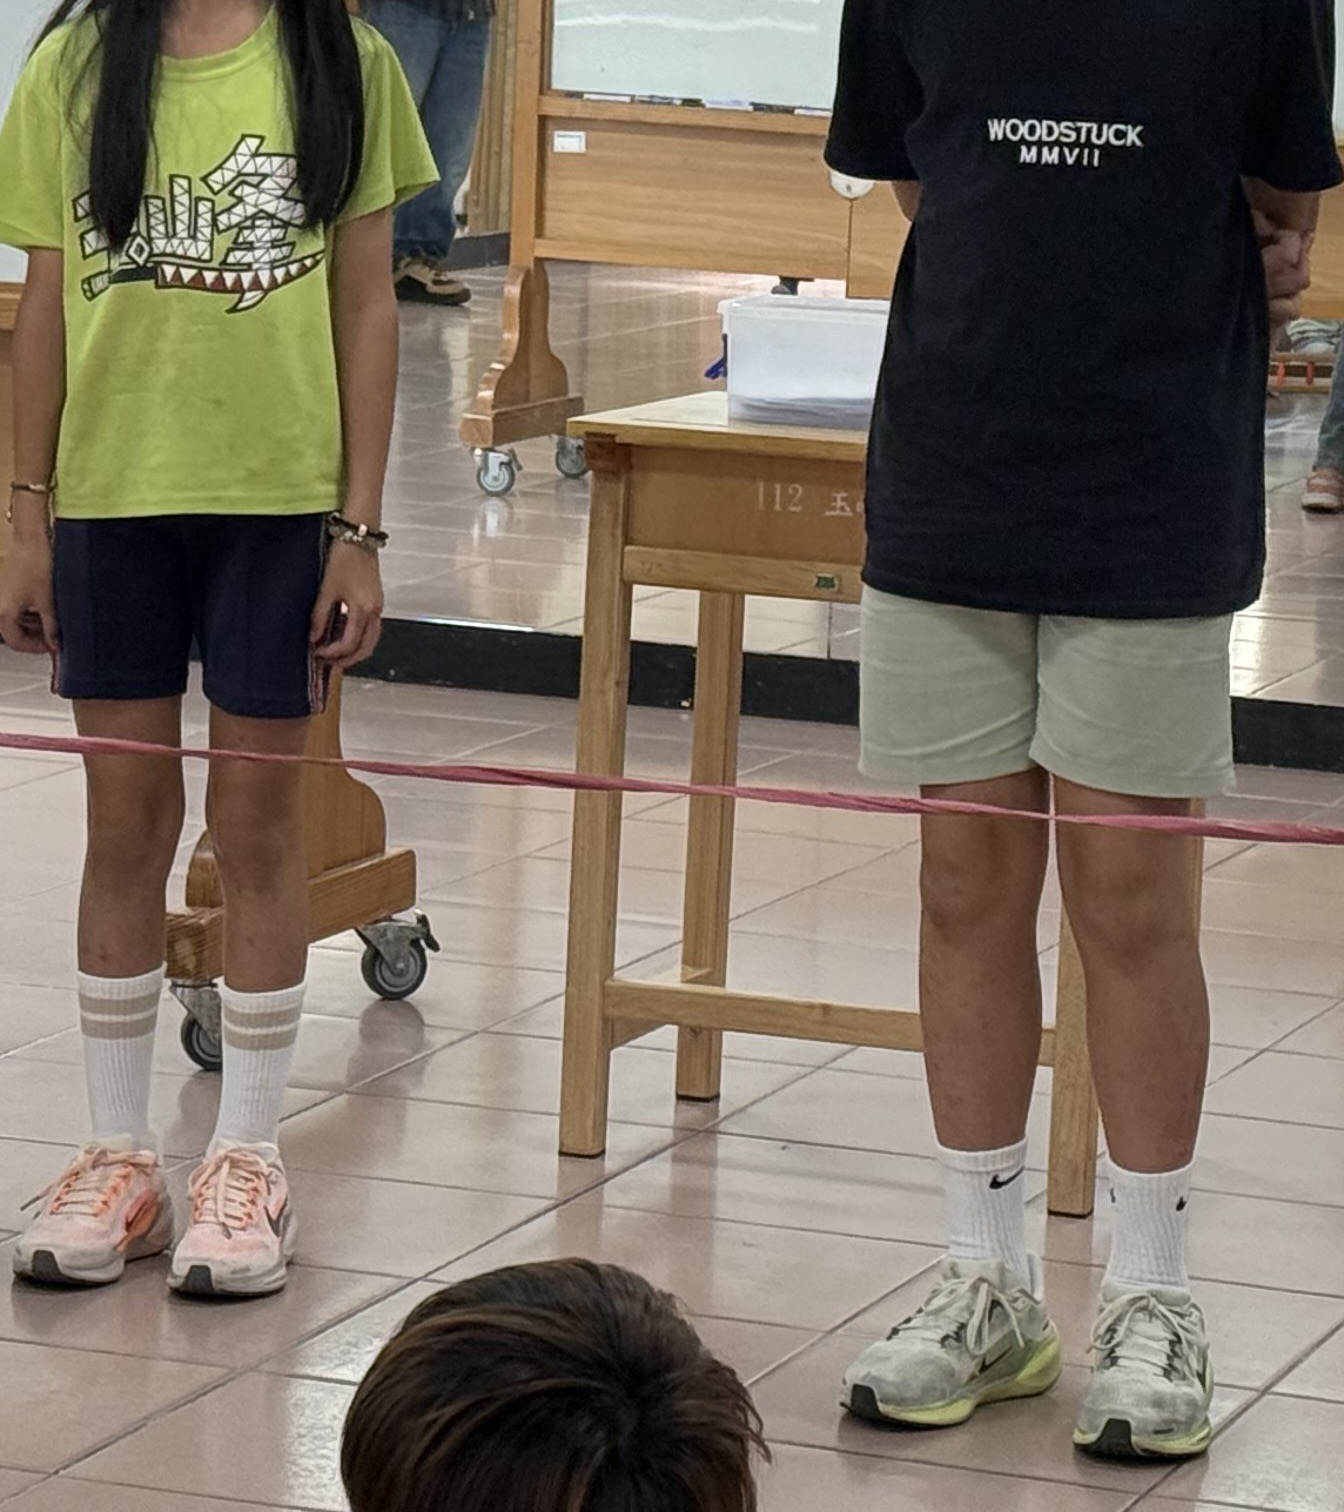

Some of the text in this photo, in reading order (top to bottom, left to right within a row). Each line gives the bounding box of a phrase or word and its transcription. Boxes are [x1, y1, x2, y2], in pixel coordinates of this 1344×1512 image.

[987, 118, 1145, 148] WOODSTUCK
[1019, 145, 1101, 168] MMVII
[757, 480, 865, 517] 112 玉
